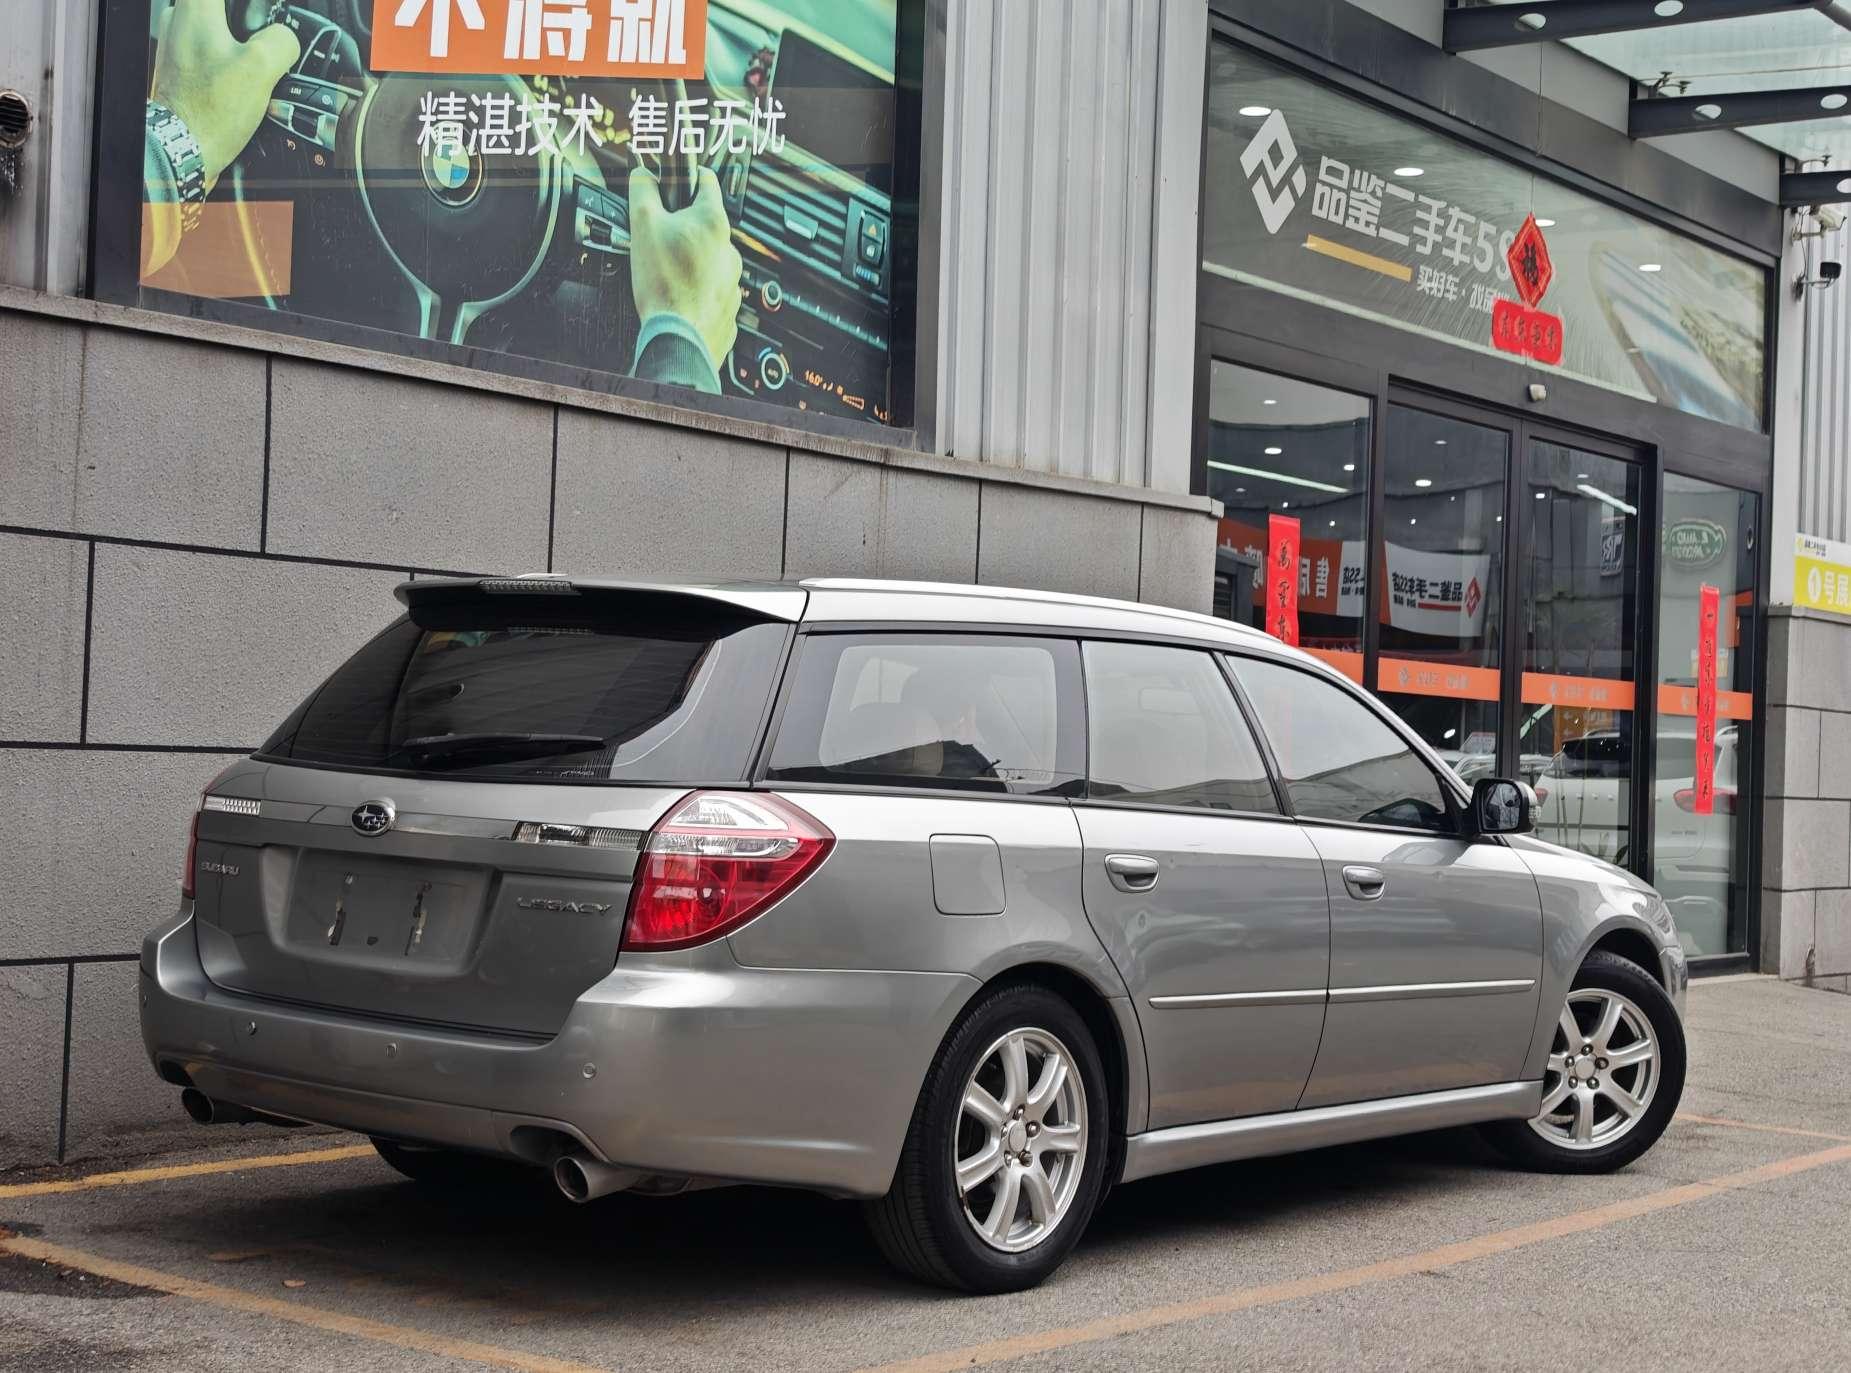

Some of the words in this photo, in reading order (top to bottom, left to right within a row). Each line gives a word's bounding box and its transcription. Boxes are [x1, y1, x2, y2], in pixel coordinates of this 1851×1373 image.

[417, 91, 603, 156] 精湛技术
[628, 97, 786, 156] 售后无忧
[517, 897, 612, 913] LEGACY
